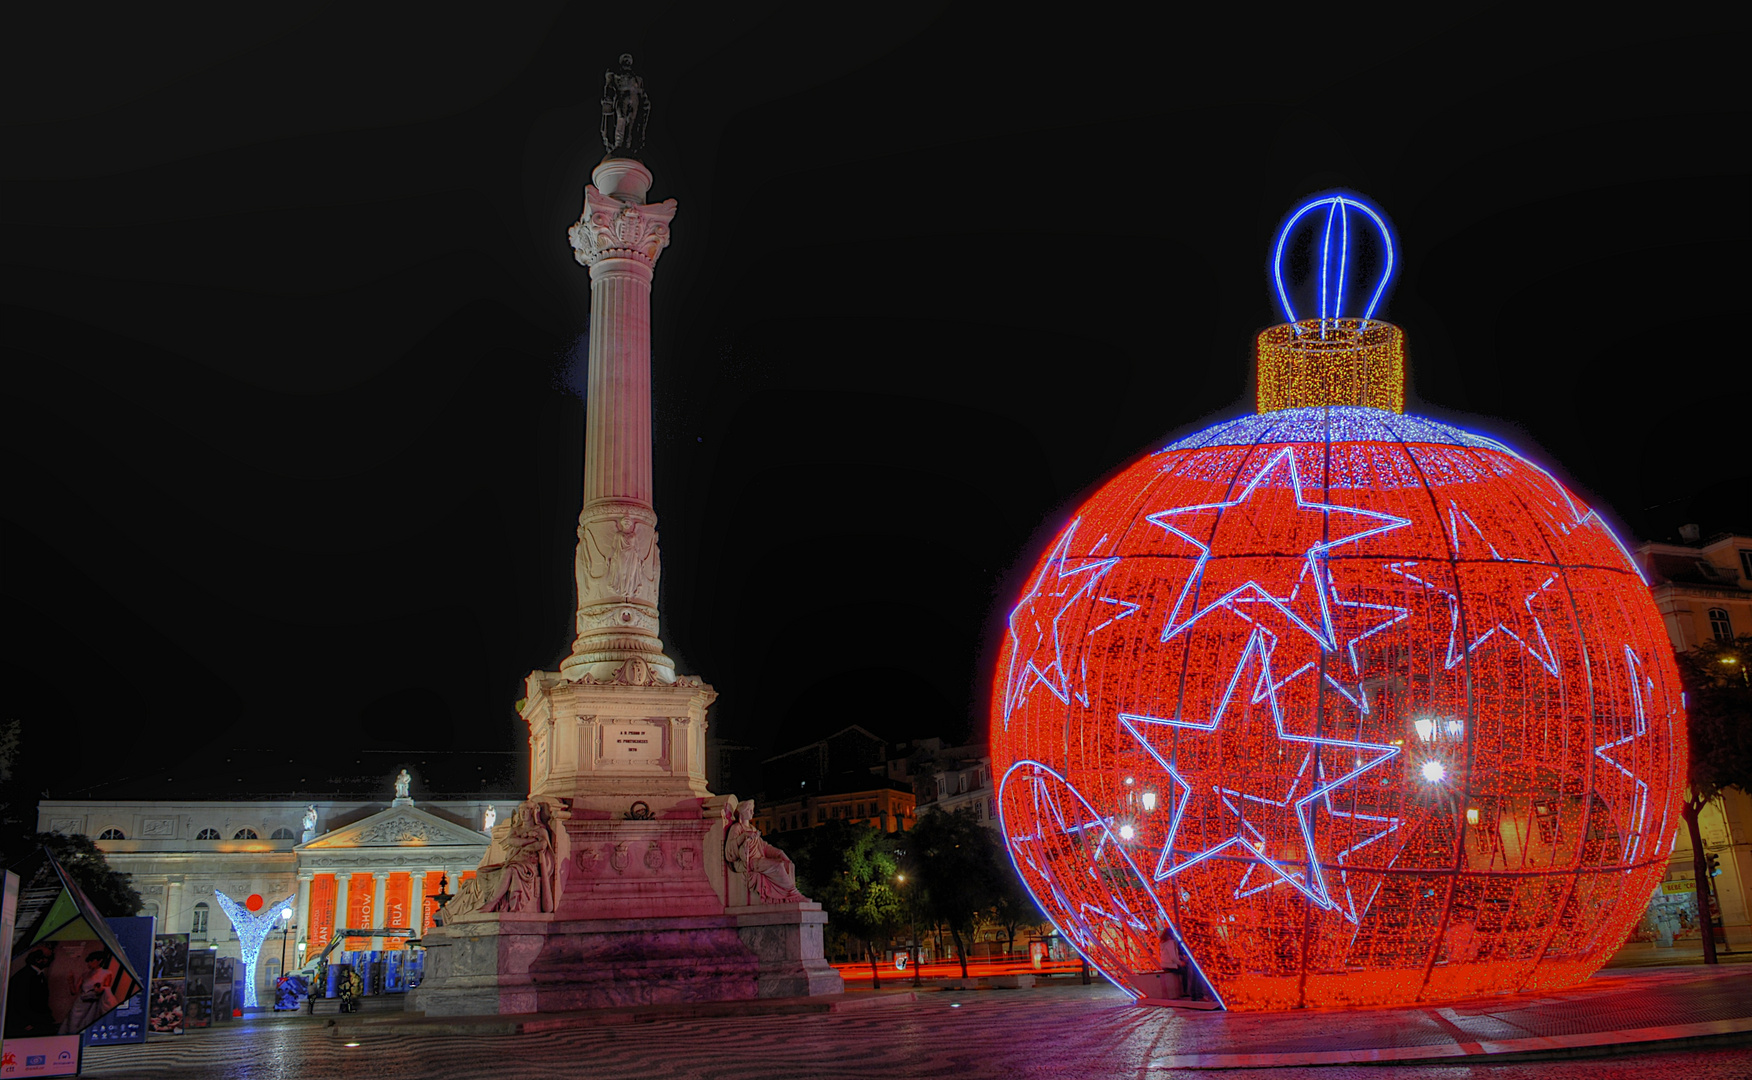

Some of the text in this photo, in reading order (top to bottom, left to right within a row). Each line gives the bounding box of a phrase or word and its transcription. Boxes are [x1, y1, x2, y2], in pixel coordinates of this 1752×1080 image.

[361, 893, 371, 930] SHOW
[392, 903, 402, 926] RUA
[312, 909, 320, 945] TEMPORADA
[319, 926, 328, 944] JAN
